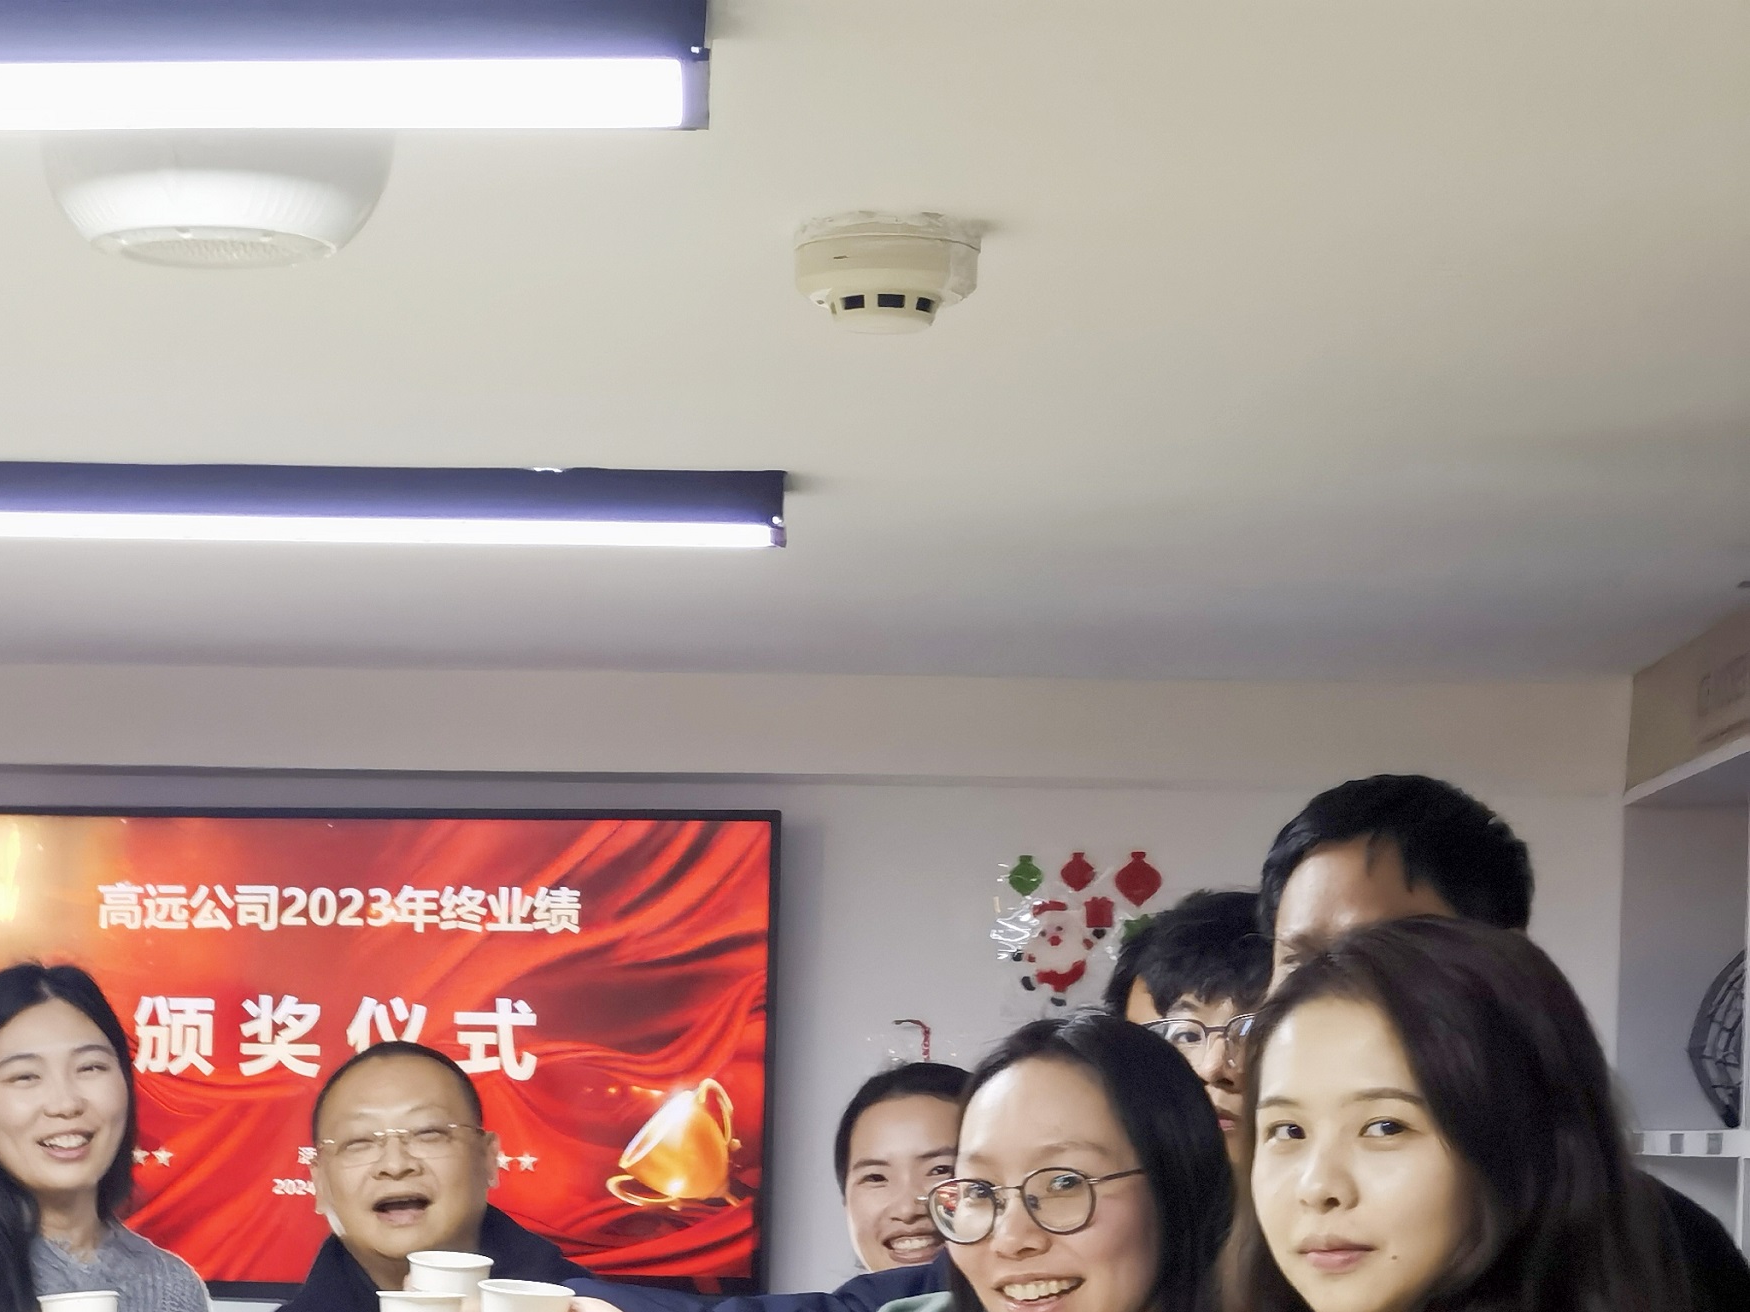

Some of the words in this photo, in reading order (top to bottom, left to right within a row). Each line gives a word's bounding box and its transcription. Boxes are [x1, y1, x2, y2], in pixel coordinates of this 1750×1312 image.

[97, 882, 581, 934] 高远公司2023年终业绩
[133, 995, 538, 1081] 颁奖仪式
